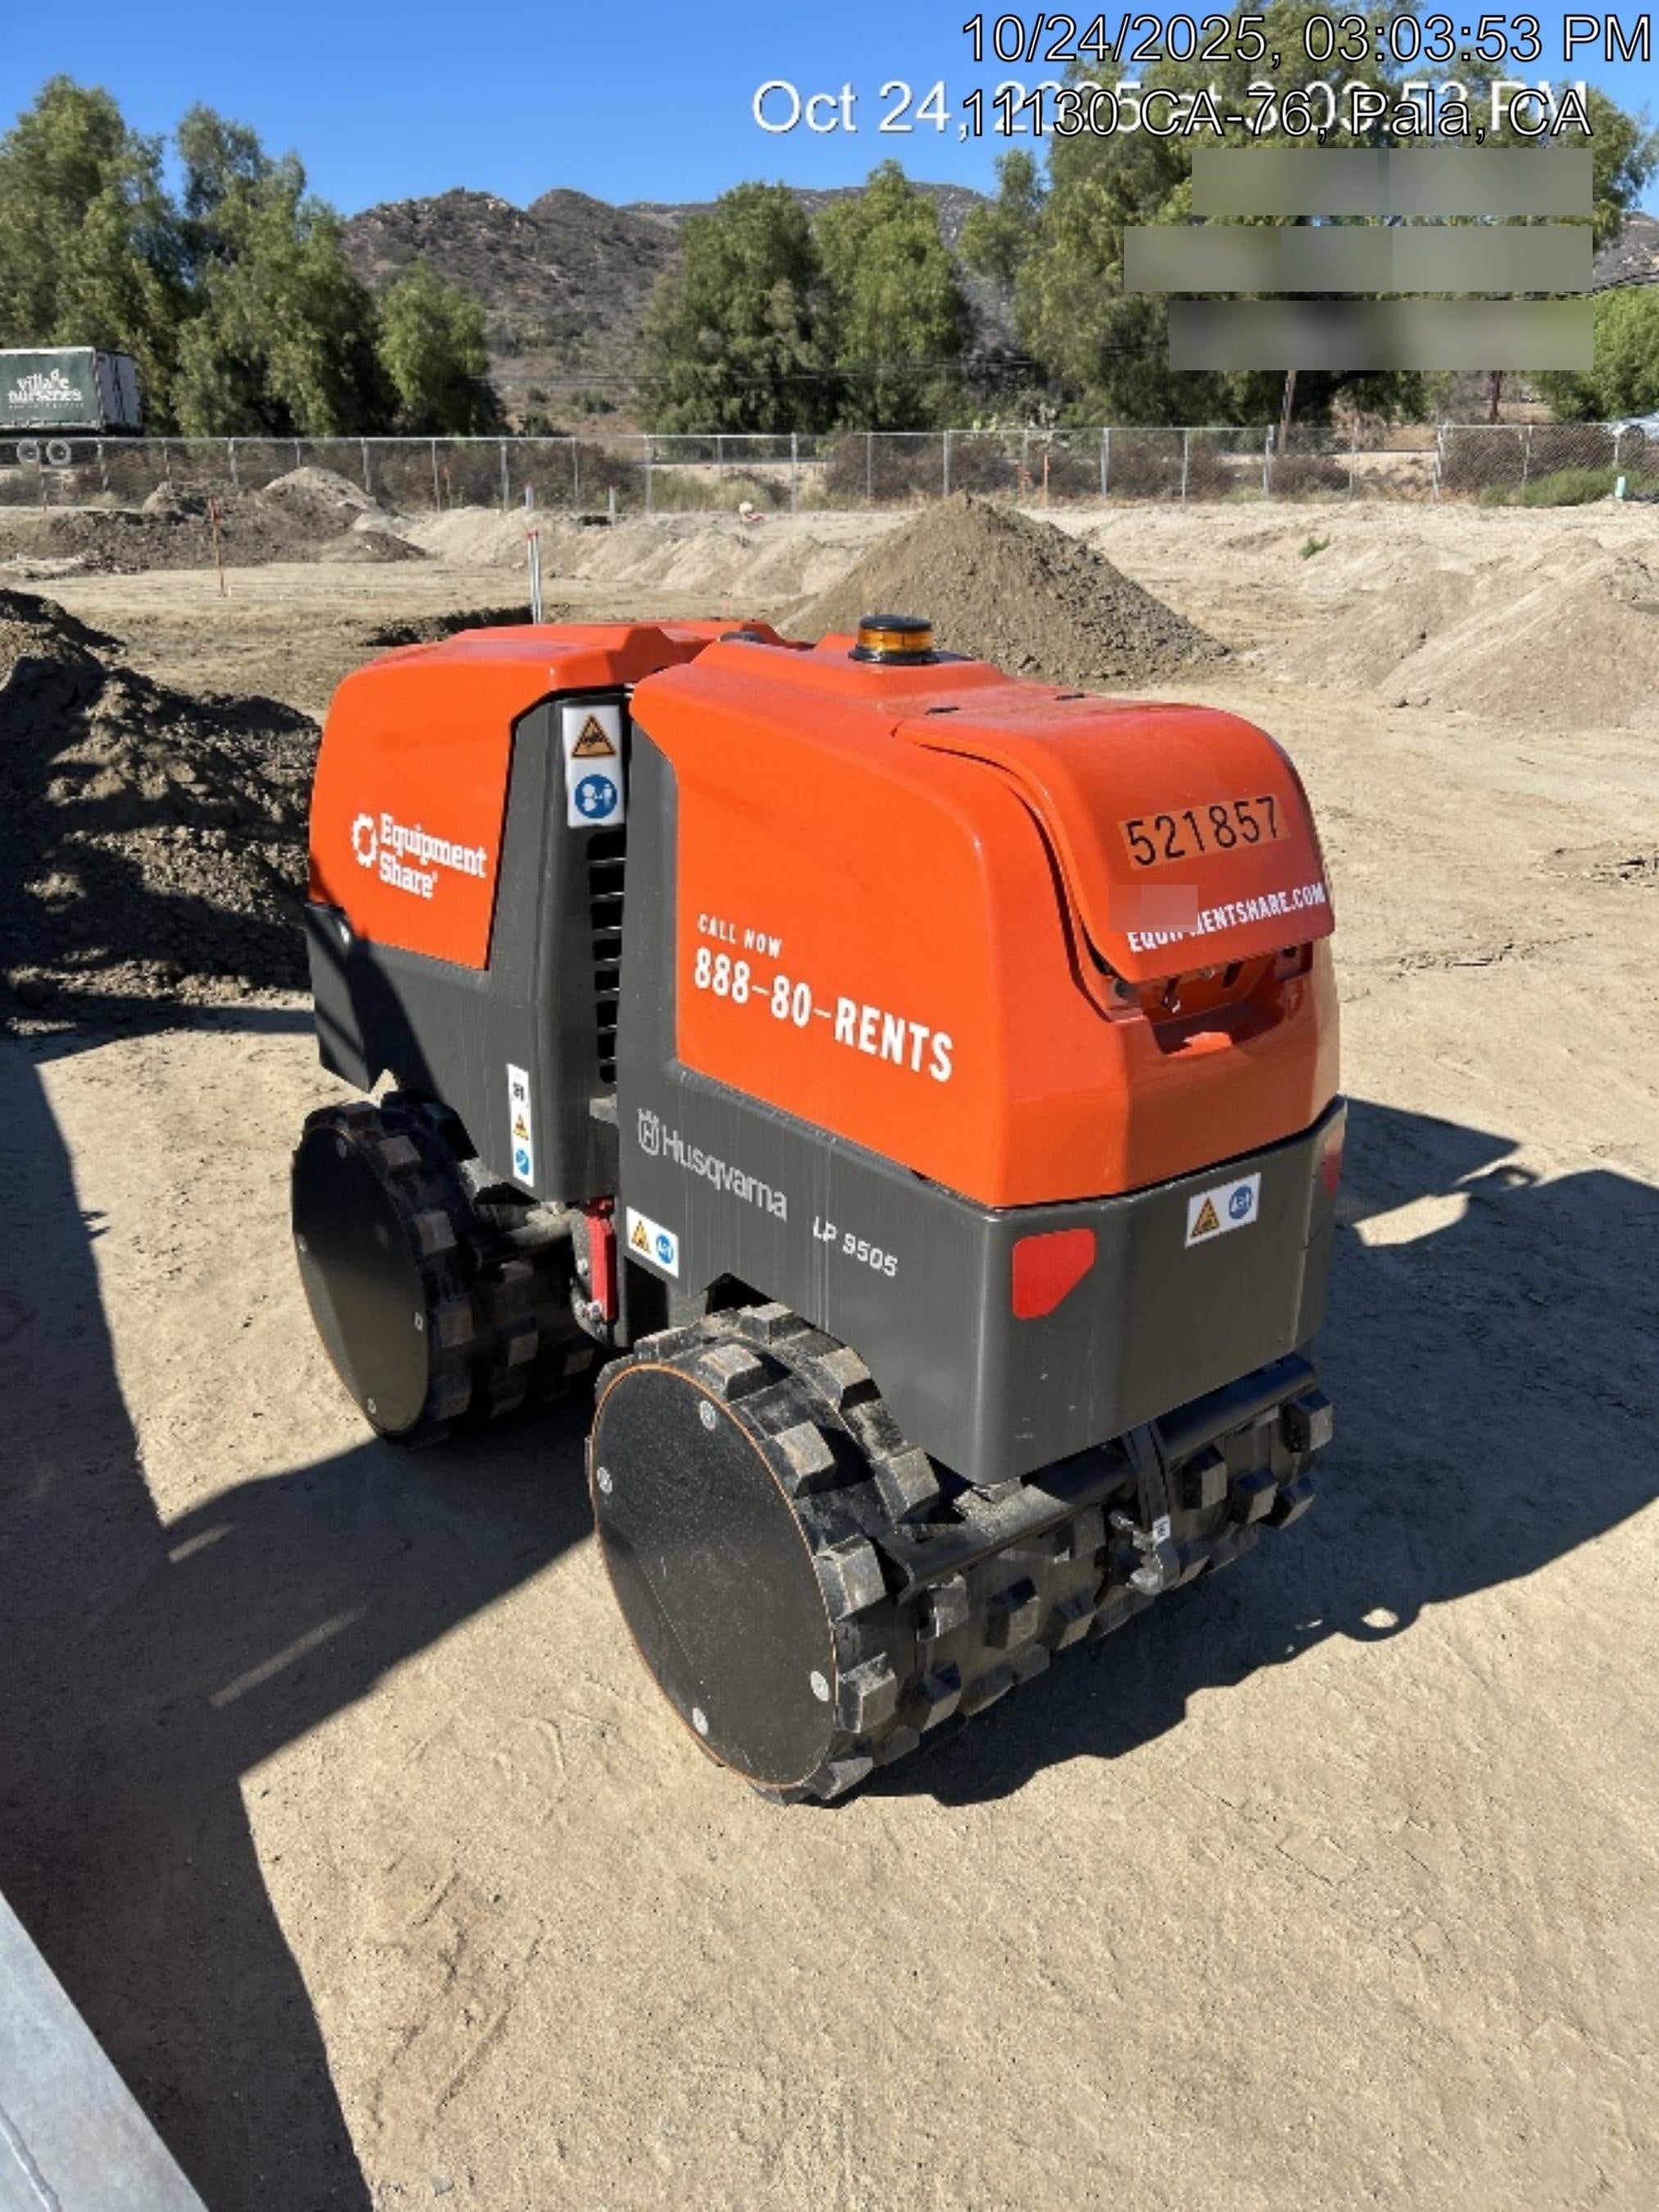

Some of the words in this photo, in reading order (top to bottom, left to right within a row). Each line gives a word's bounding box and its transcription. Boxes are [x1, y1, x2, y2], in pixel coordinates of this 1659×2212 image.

[379, 812, 487, 878] Equipment
[1126, 796, 1277, 866] 521857
[698, 913, 737, 945] CALL
[743, 928, 782, 959] NOW
[695, 946, 953, 1082] 888-80-RENTS
[663, 1124, 787, 1223] Husqvarna
[813, 1216, 837, 1242] LP
[842, 1232, 898, 1277] 9505
